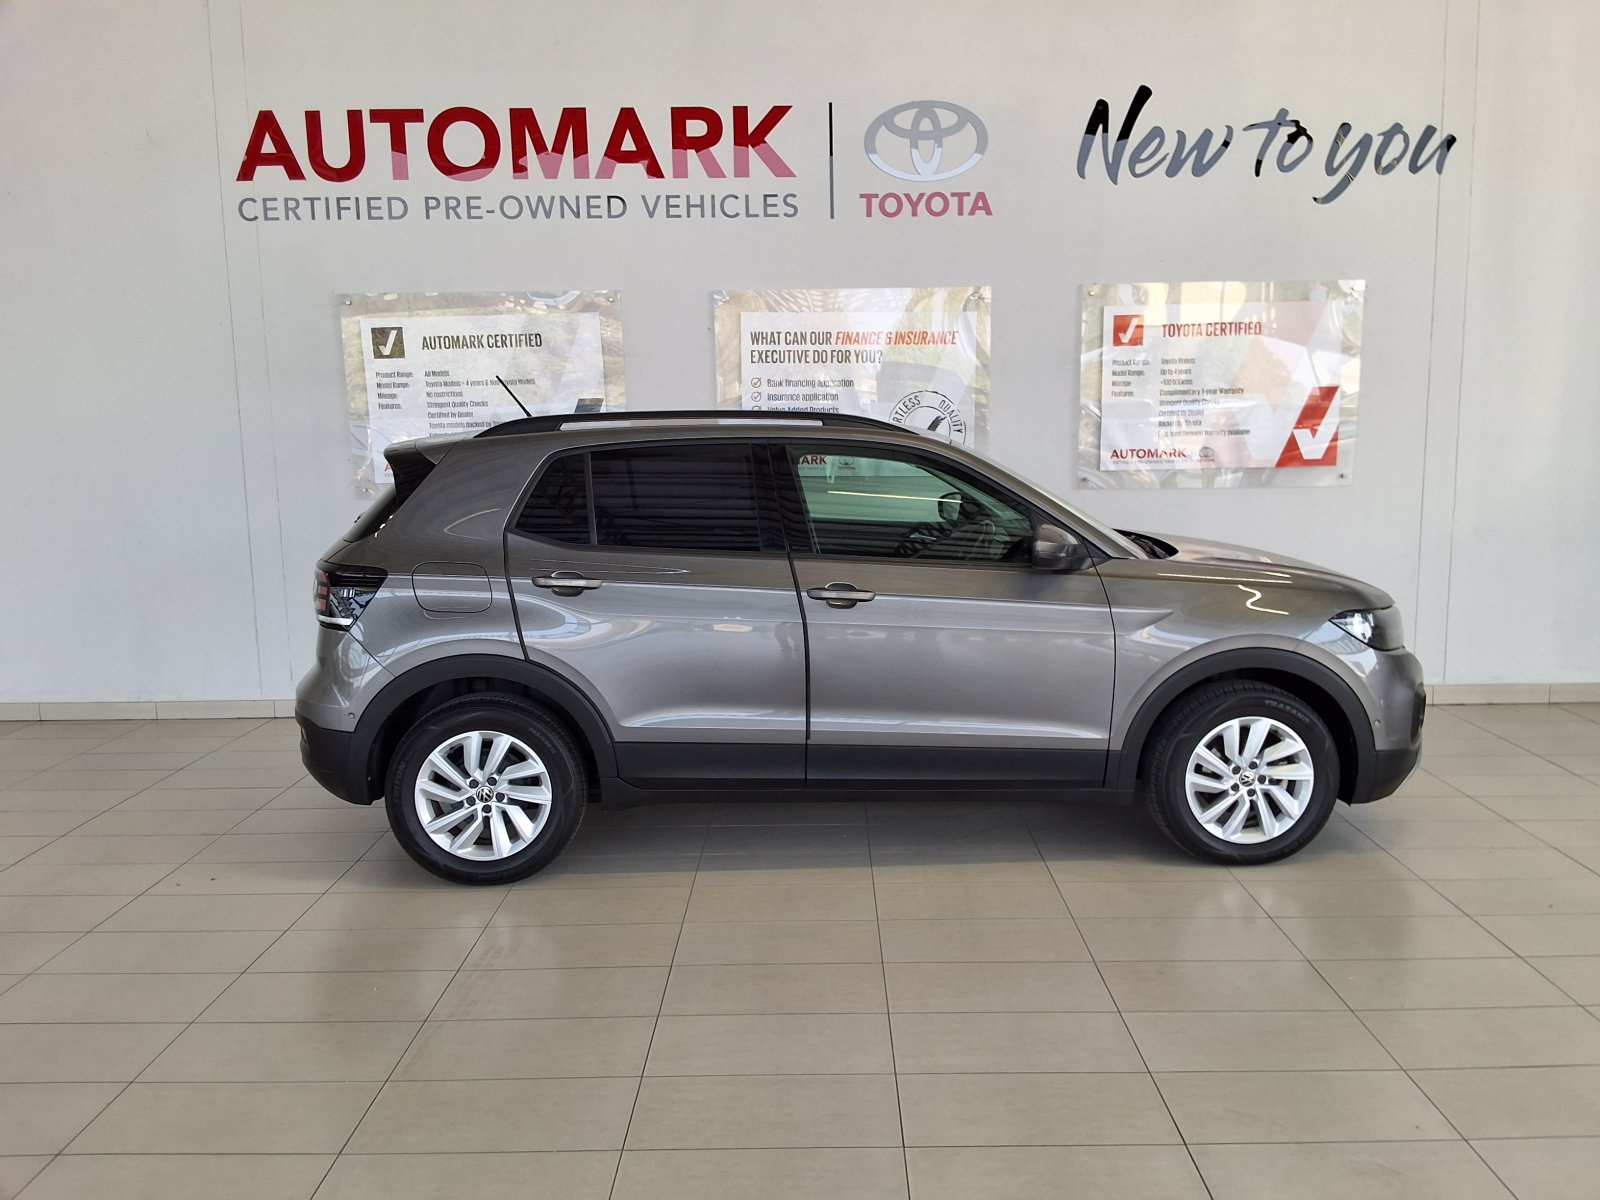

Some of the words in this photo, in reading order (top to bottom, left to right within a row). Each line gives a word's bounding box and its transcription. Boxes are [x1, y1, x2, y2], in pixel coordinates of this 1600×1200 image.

[236, 105, 798, 183] AUTOMARK
[1076, 84, 1233, 186] New
[1242, 107, 1314, 178] to
[1311, 121, 1458, 205] you
[237, 196, 409, 223] CERTIFIED
[424, 194, 627, 221] PRE-OWNED
[641, 192, 799, 219] VEHICLES
[859, 191, 993, 219] TOYOTA
[750, 331, 782, 346] WHAT
[784, 331, 808, 346] CAN
[809, 331, 833, 345] OUR
[834, 331, 883, 346] FINANCE
[893, 330, 959, 345] INSURANCE
[1162, 323, 1203, 338] TOYOTA
[1205, 321, 1262, 337] CERTIFIED
[421, 334, 485, 351] AUTOMARK
[486, 333, 543, 349] CERTIFIED
[750, 349, 810, 364] EXECUTIVE
[812, 349, 829, 364] DO
[830, 349, 852, 364] FOR
[854, 349, 883, 364] YOU?
[766, 378, 784, 388] Bank
[784, 378, 816, 389] financing
[817, 378, 855, 389] application
[451, 400, 469, 409] Quality
[469, 400, 489, 408] Checks
[767, 392, 801, 402] Insurance
[801, 392, 839, 403] application
[892, 394, 921, 424] RTLESS
[938, 399, 964, 434] QUALITY
[1110, 447, 1188, 460] AUTOMARK
